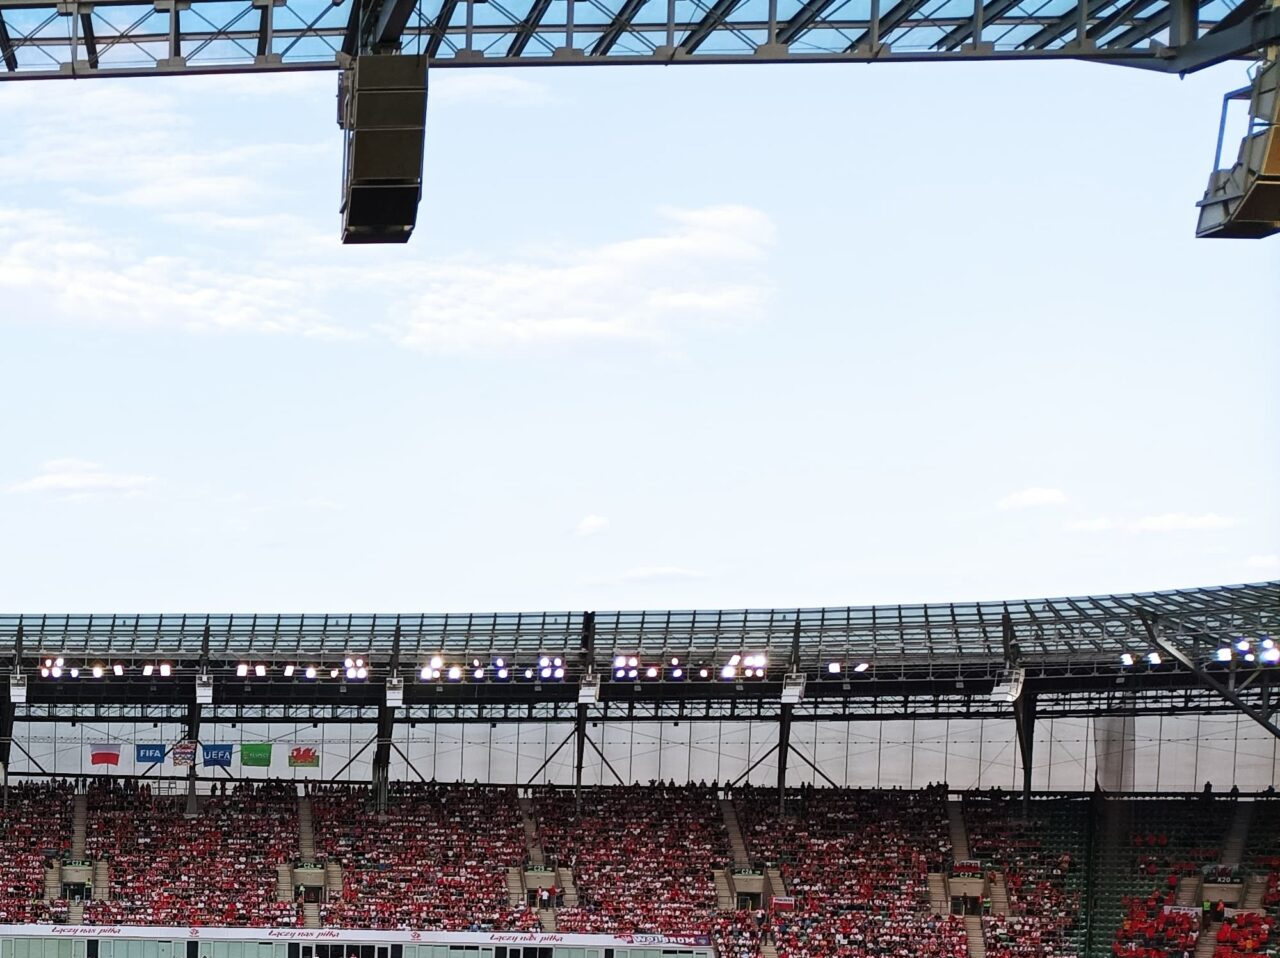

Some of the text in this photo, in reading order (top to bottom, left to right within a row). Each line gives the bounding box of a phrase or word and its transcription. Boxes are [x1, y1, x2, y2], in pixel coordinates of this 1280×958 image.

[140, 749, 161, 757] FIFA
[204, 751, 231, 760] UEFA
[51, 926, 78, 935] Łączy
[97, 926, 121, 935] piłka
[268, 930, 295, 938] Łączy
[316, 930, 339, 938] piłka
